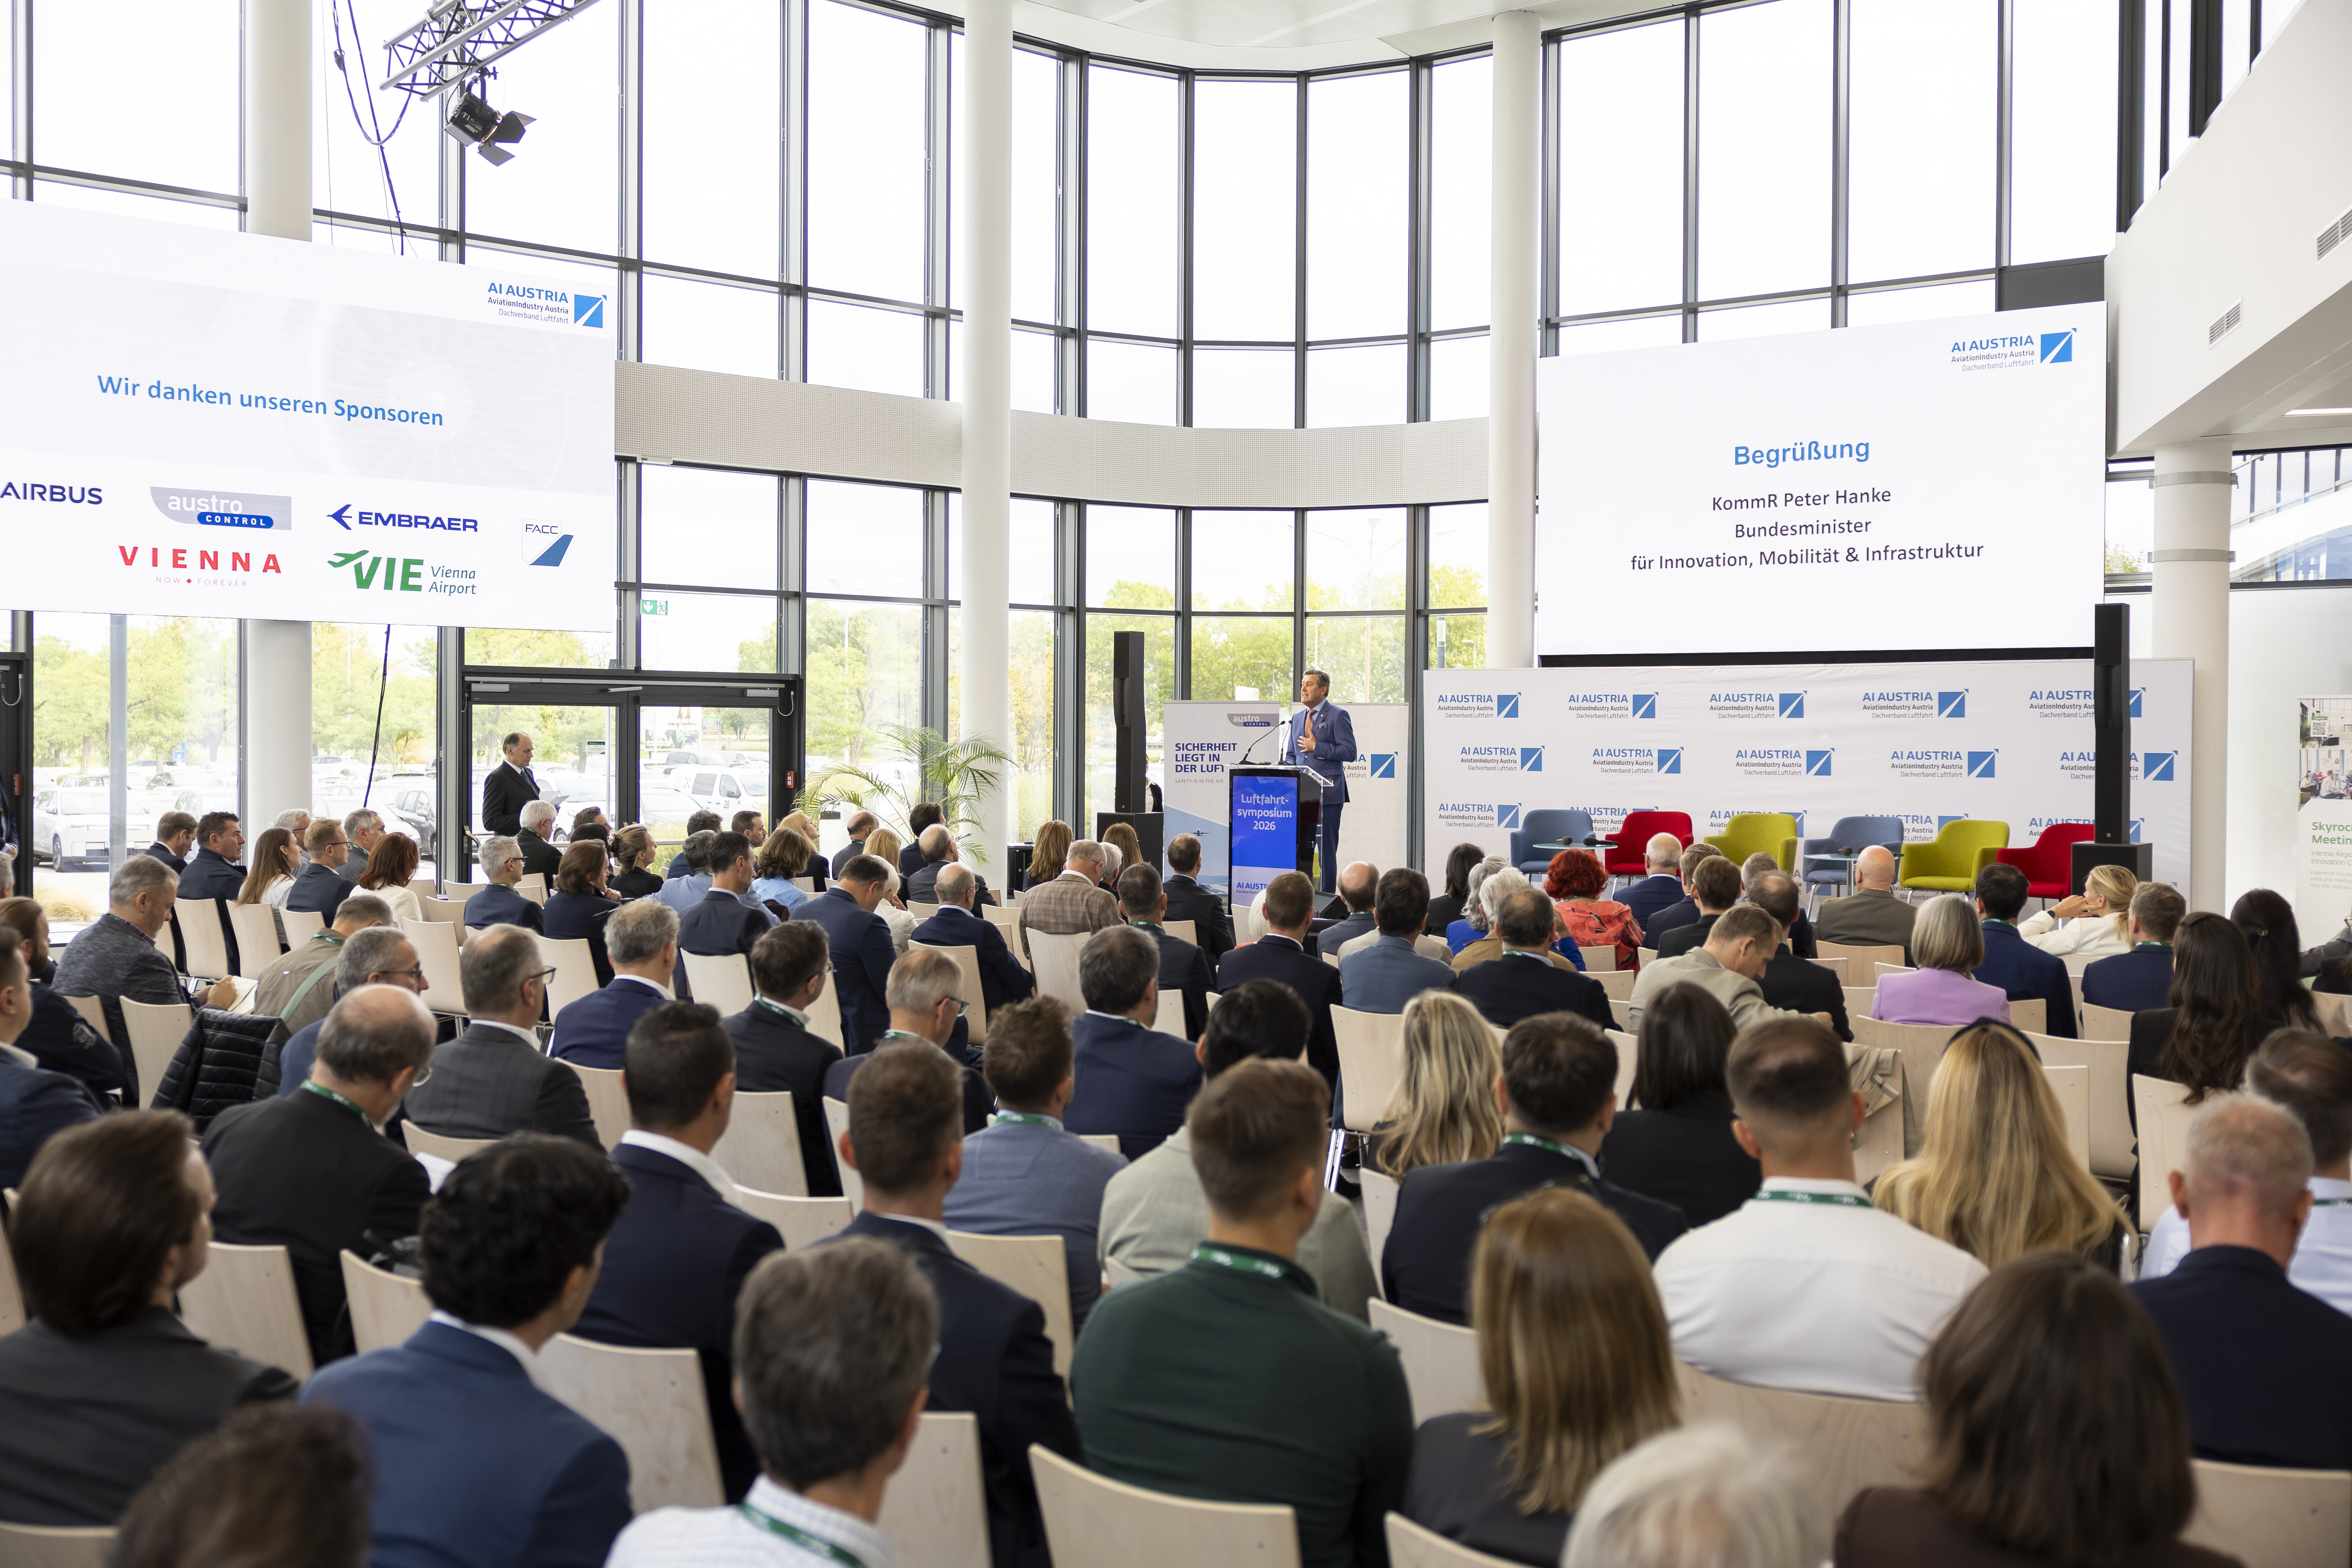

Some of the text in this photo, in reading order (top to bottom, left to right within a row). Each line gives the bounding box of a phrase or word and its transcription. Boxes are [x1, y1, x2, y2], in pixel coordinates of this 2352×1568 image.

[488, 283, 568, 303] AI AUSTRIA
[488, 297, 568, 314] AviationIndustry Austria
[499, 309, 568, 324] Dachverband Luftfahrt
[1951, 336, 2034, 352] AI AUSTRIA
[1951, 353, 2007, 362] AviationIndustry
[1963, 362, 2003, 371] Dachverband
[98, 376, 442, 425] Wir danken unseren Sponsoren
[1735, 441, 1869, 468] Begrüßung
[0, 482, 102, 505] AIRBUS
[1713, 488, 1891, 510] KommR Peter Hanke
[168, 494, 243, 516] austro
[205, 515, 266, 526] CONTROL
[359, 512, 477, 532] EMBRAER
[526, 524, 558, 534] FACC
[1736, 519, 1871, 537] Bundesminister
[118, 546, 281, 573] VIENNA
[1631, 543, 1984, 570] für Innovation, Mobilität & Infrastruktur
[354, 557, 475, 592] VIE Vienna
[429, 581, 476, 596] Airport
[1878, 692, 1933, 701] AUSTRIA
[2030, 691, 2094, 700] AI AUSTR
[1750, 750, 1801, 759] AUSTRIA
[1891, 751, 1962, 760] AI AUSTRIA
[2060, 752, 2074, 761] AI
[724, 800, 730, 809] 28
[1241, 794, 1288, 805] Luftfahrt-
[1238, 807, 1292, 818] symposium
[1450, 804, 1494, 812] AUSTRIA
[1710, 811, 1720, 819] AI
[1253, 821, 1276, 830] 2026
[2029, 818, 2042, 827] AI
[2312, 822, 2352, 833] Skyroc
